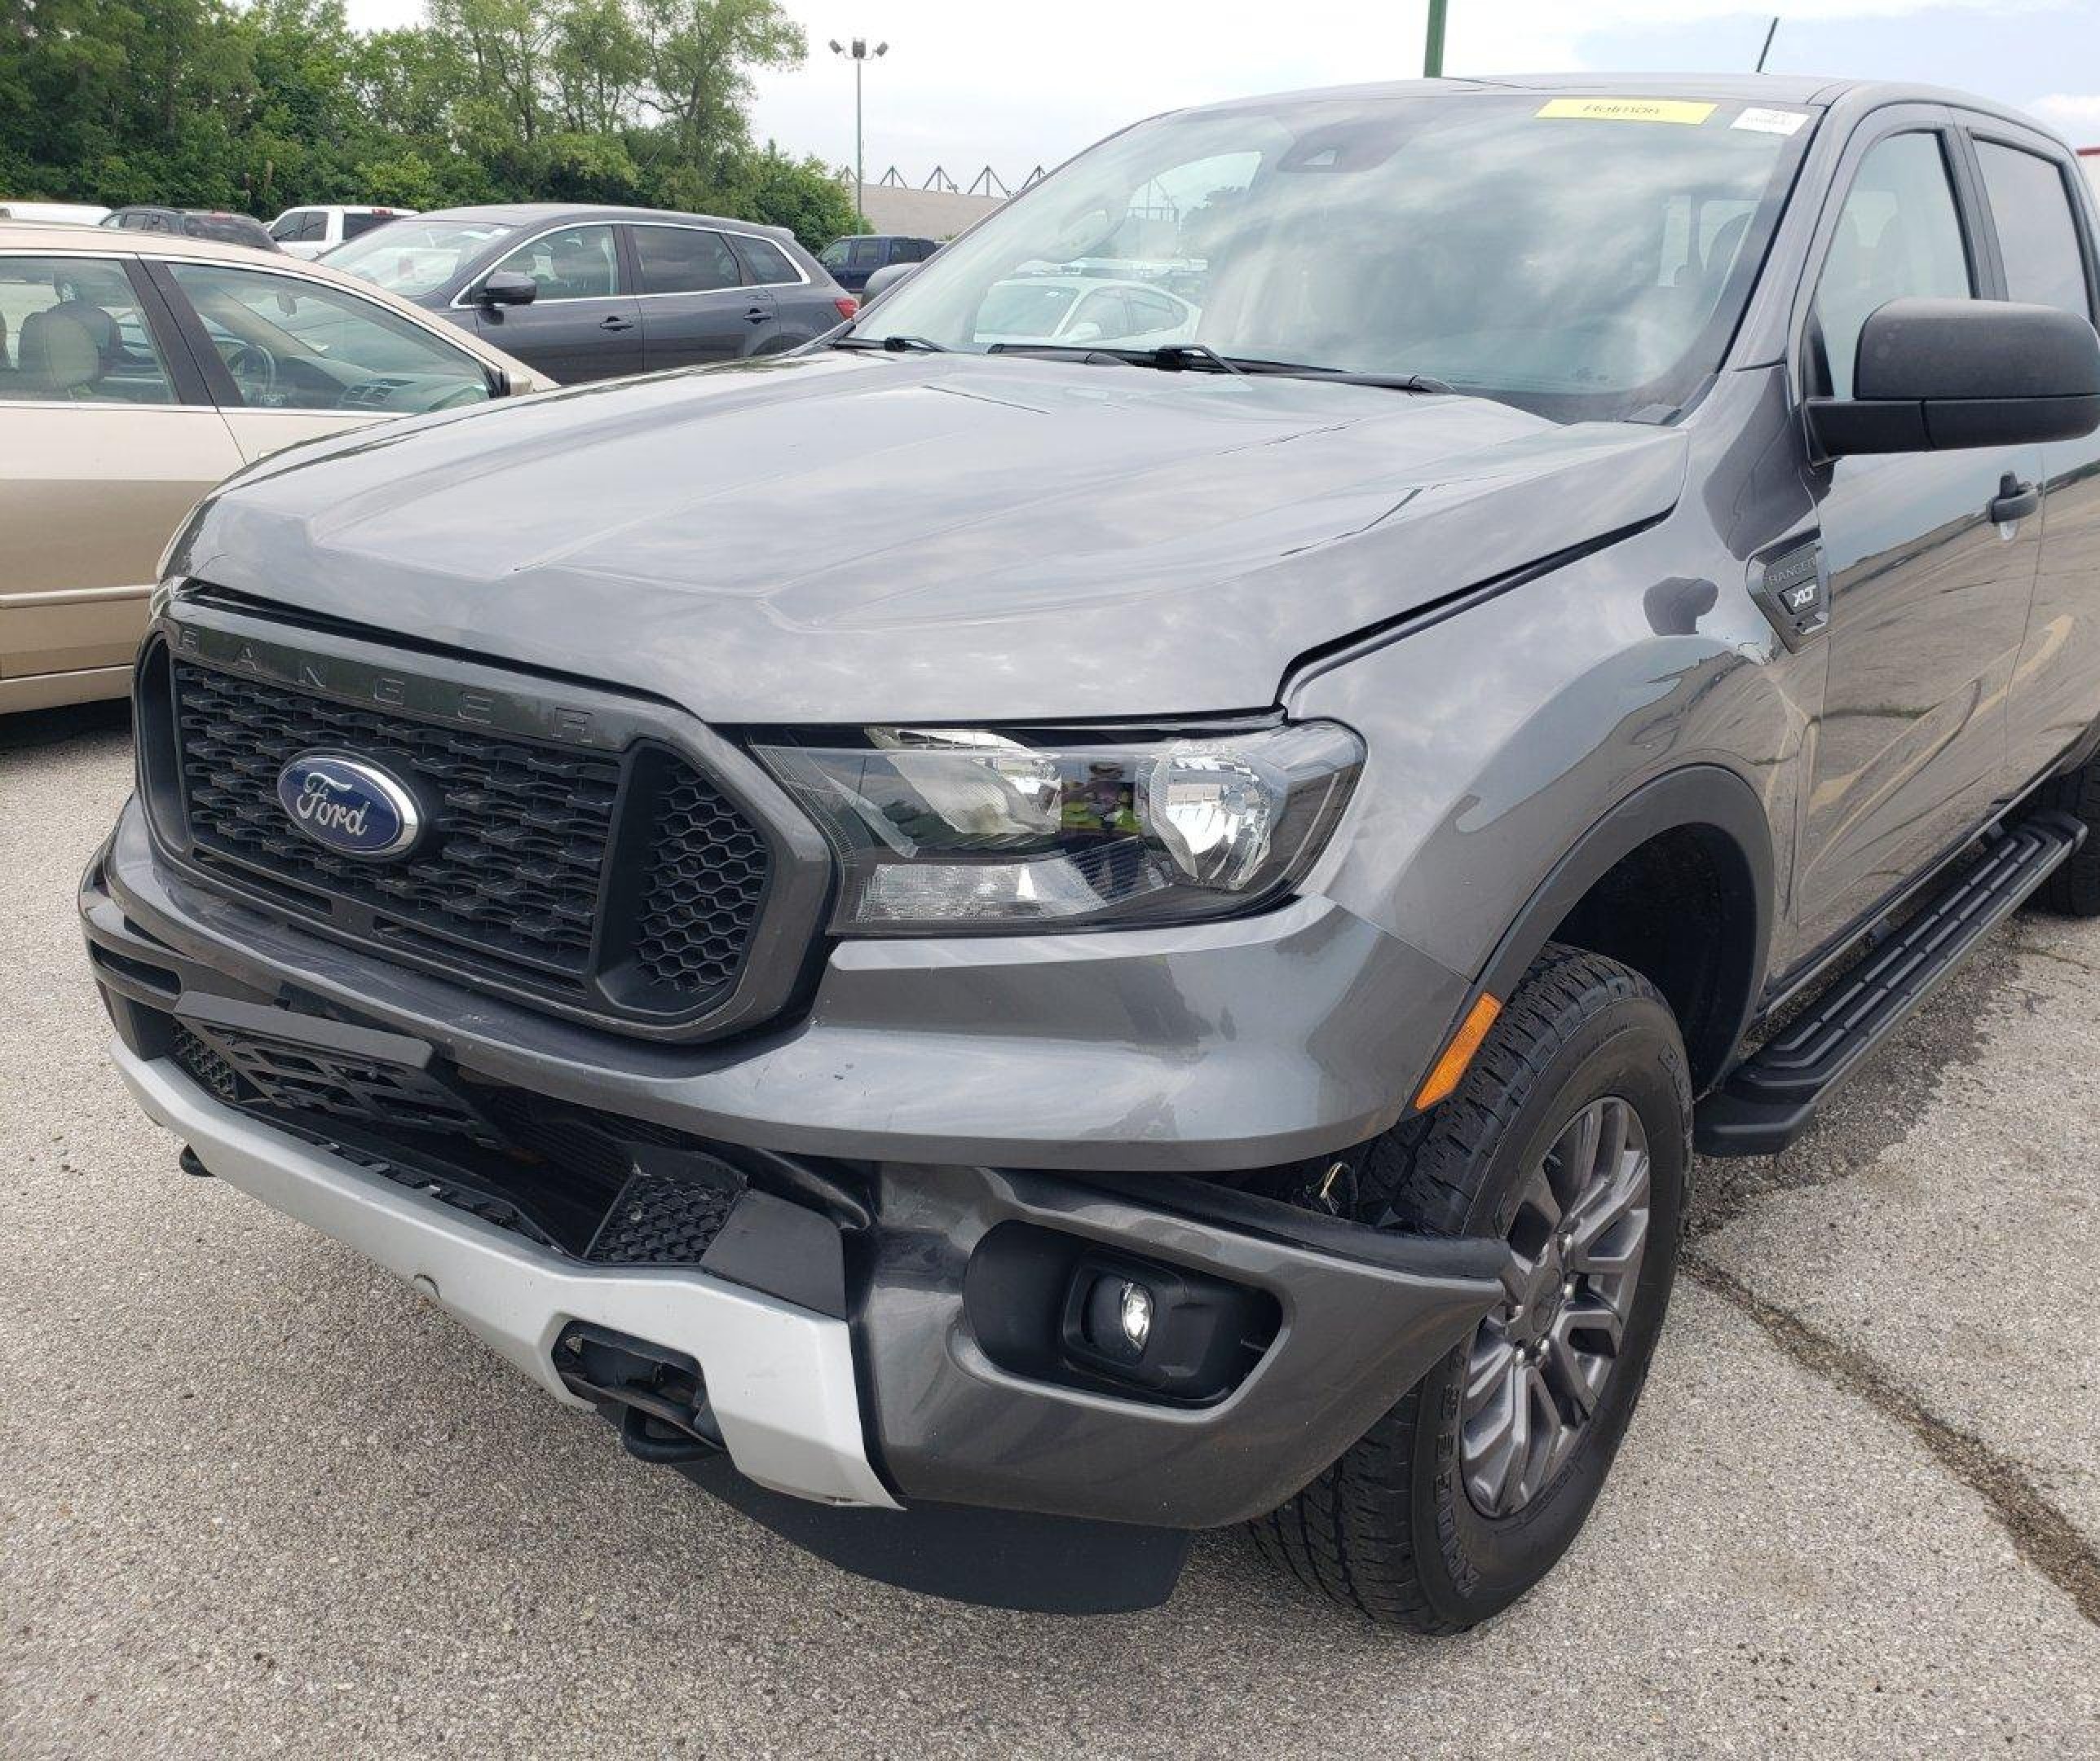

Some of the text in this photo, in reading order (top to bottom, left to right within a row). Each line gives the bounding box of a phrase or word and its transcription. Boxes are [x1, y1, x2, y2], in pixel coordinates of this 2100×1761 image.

[1768, 556, 1815, 585] RANGER
[1791, 584, 1817, 607] XLT
[176, 625, 594, 744] RANGER
[295, 771, 369, 836] Ford
